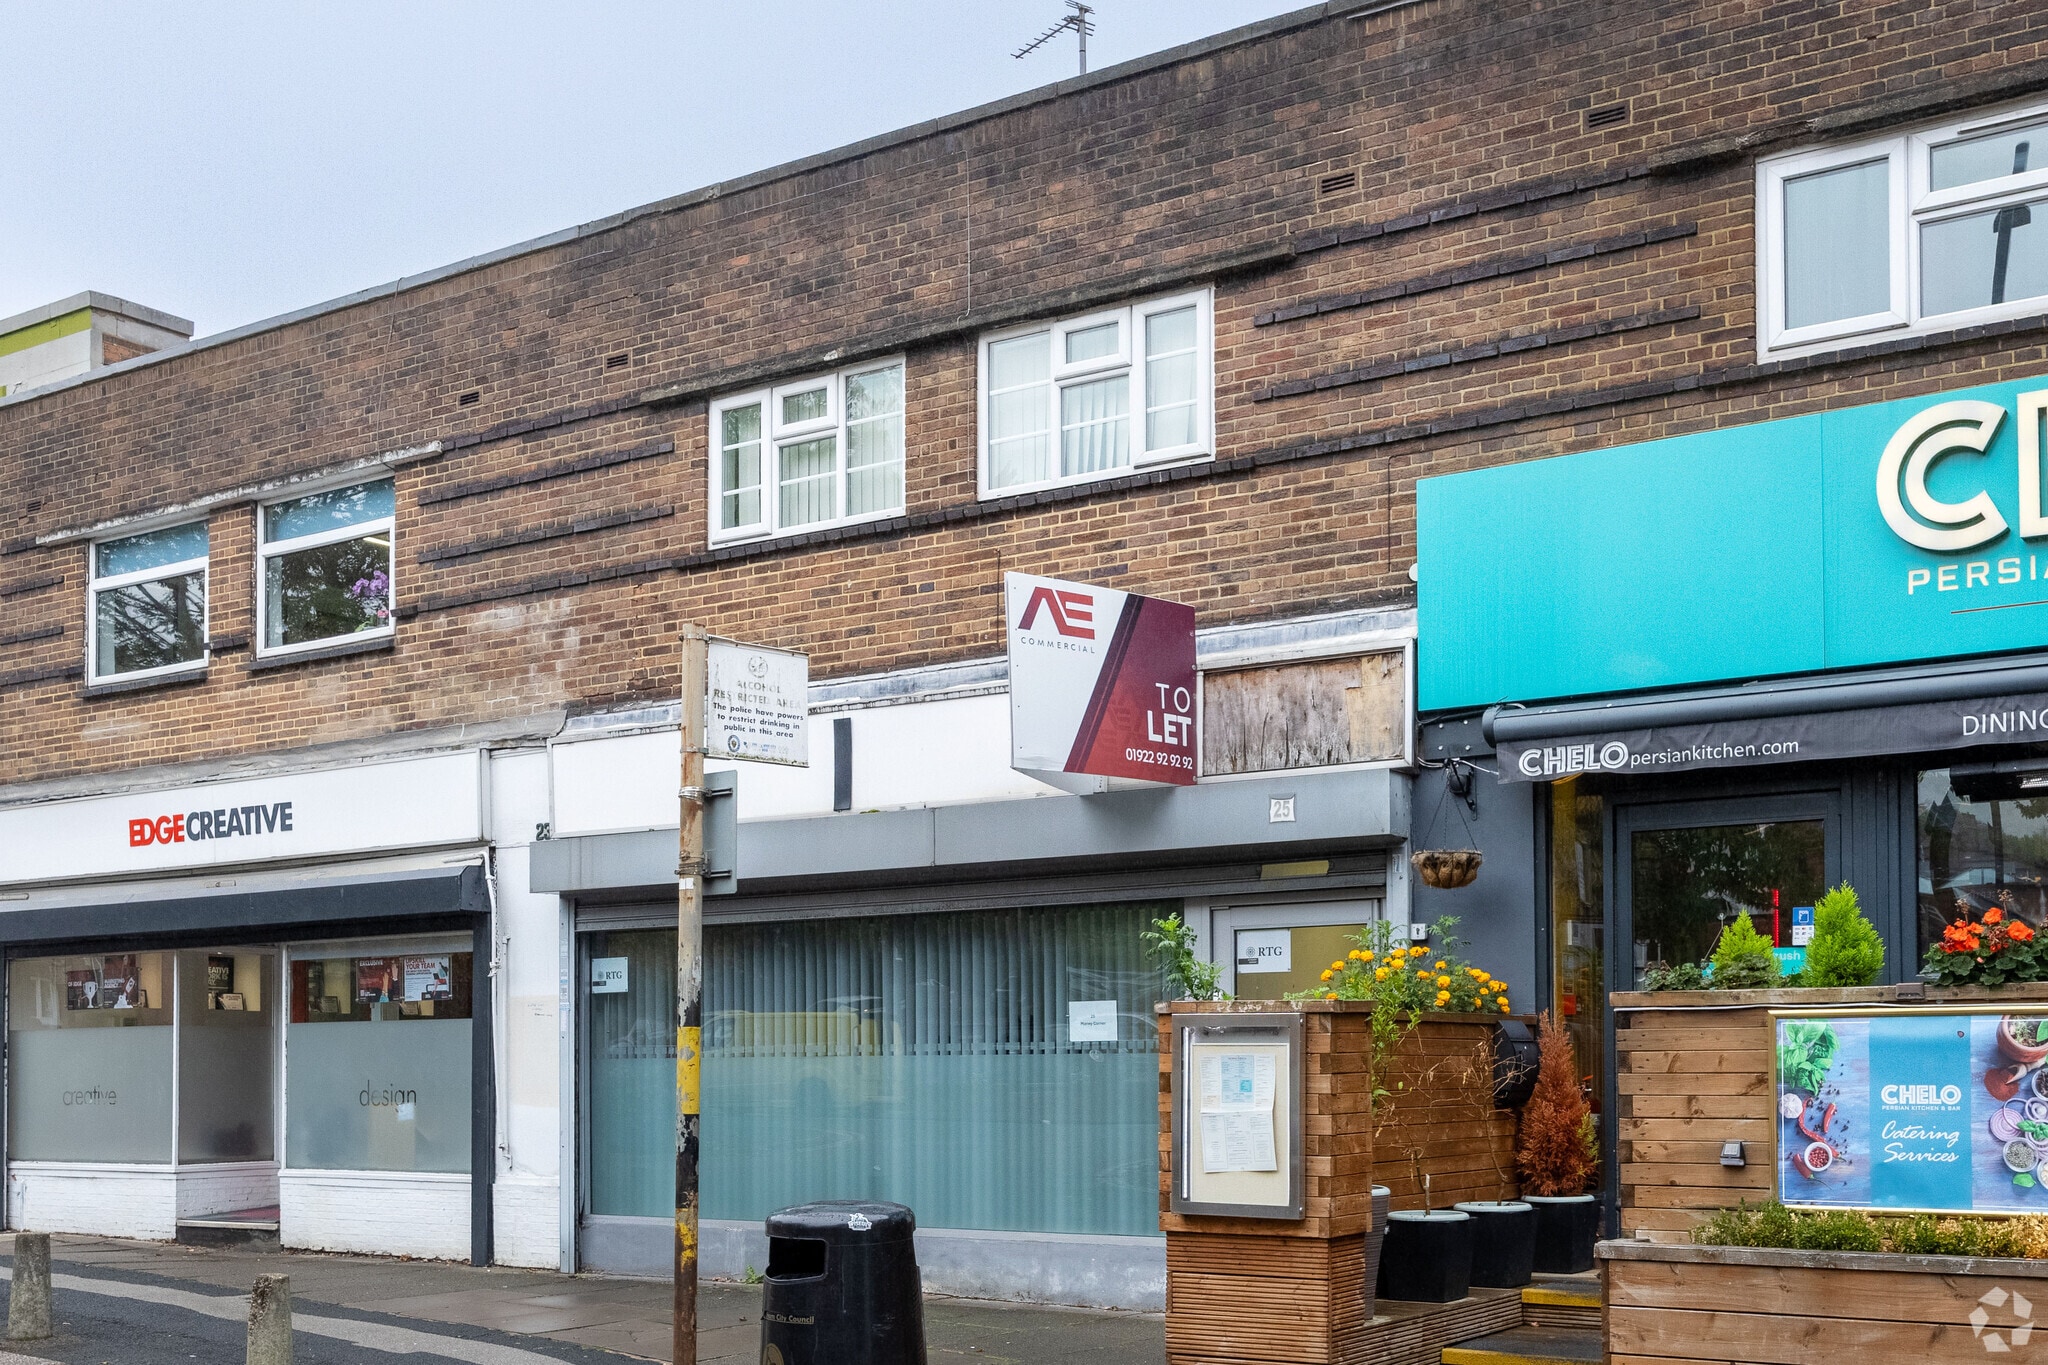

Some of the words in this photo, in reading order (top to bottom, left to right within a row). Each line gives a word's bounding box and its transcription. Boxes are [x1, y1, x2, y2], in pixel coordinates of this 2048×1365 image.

[1907, 554, 2048, 595] PERSI
[1020, 636, 1095, 654] COMMERCIAL
[1155, 682, 1191, 714] TO
[713, 702, 727, 711] The
[730, 705, 753, 715] police
[756, 707, 774, 717] have
[777, 711, 804, 721] powers
[729, 714, 756, 724] restrict
[760, 718, 790, 730] drinking
[793, 722, 800, 730] in
[723, 724, 746, 733] public
[759, 728, 773, 736] this
[776, 731, 794, 739] area
[1147, 710, 1192, 747] LET
[1125, 747, 1155, 764] 01922
[1156, 751, 1169, 766] 92
[1170, 753, 1182, 767] 92
[1182, 756, 1193, 770] 92
[1273, 800, 1291, 818] 25
[536, 822, 551, 842] 23
[1258, 946, 1283, 957] RTG
[605, 970, 623, 980] RTG
[62, 1083, 117, 1105] creative
[359, 1079, 417, 1113] design
[1880, 1084, 1962, 1106] CHELO
[1881, 1120, 1960, 1149] Catering
[1883, 1142, 1960, 1164] Services
[788, 1315, 815, 1324] Council
